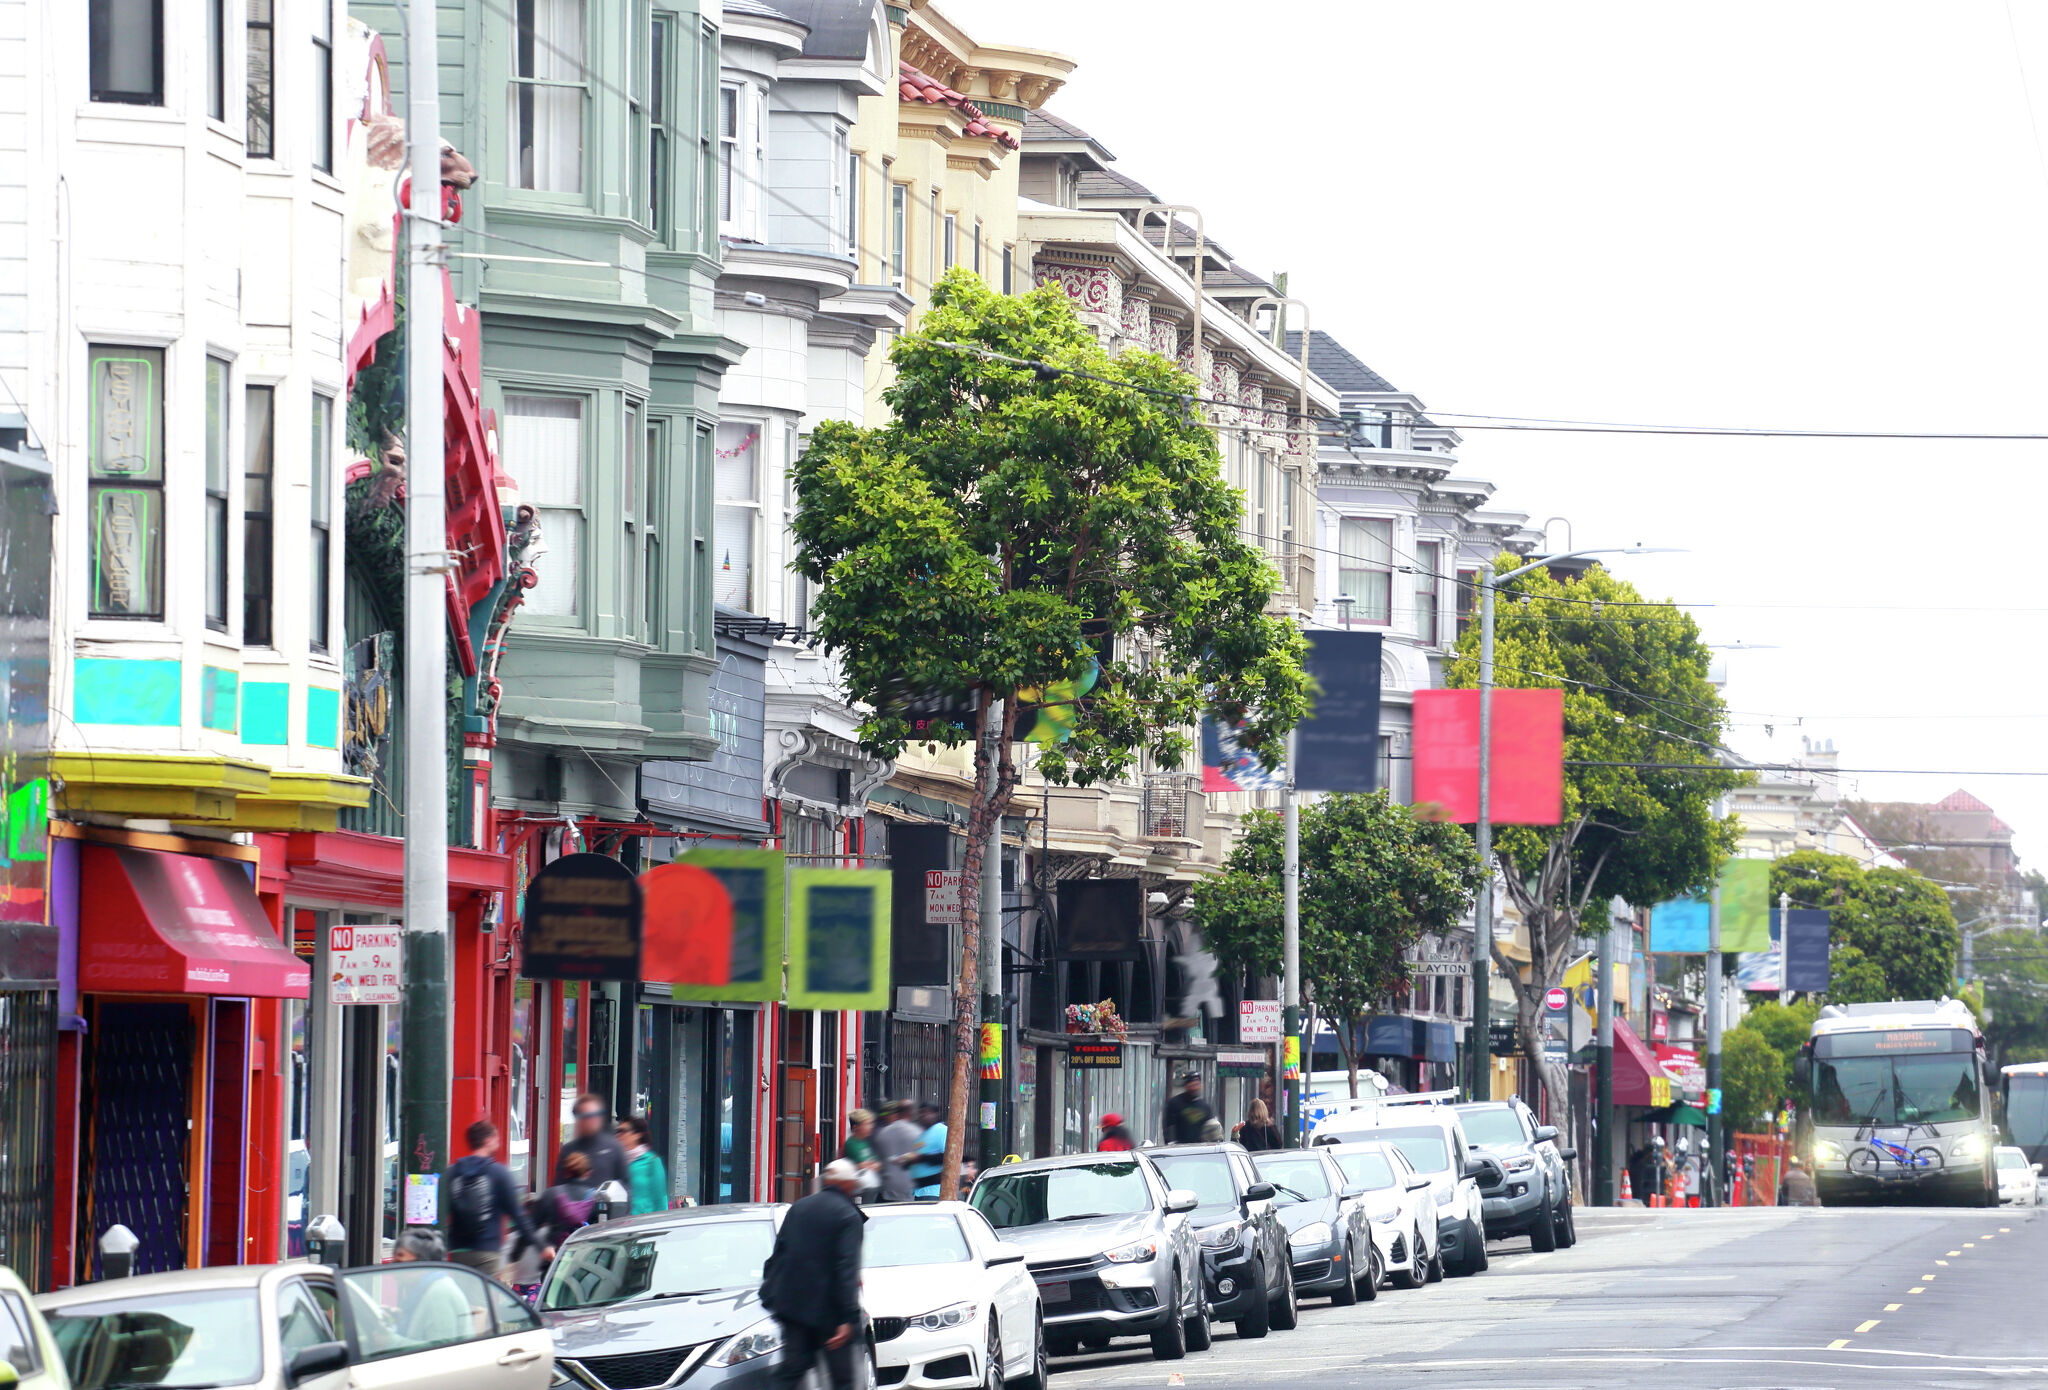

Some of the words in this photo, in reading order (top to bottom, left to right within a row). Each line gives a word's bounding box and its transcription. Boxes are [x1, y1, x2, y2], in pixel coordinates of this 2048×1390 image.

[927, 872, 941, 887] NO
[943, 876, 964, 886] PARK
[930, 903, 944, 912] MON
[946, 903, 960, 912] WED
[333, 929, 352, 949] NO
[356, 933, 397, 947] PARKING
[359, 974, 377, 987] WED
[382, 974, 398, 986] FRI
[364, 992, 397, 1001] CLEANING
[1242, 1002, 1252, 1013] NO
[1886, 1032, 1923, 1041] MASONIC
[1071, 1055, 1083, 1064] 20%
[1084, 1055, 1094, 1064] OFF
[1096, 1056, 1120, 1064] DRESSES
